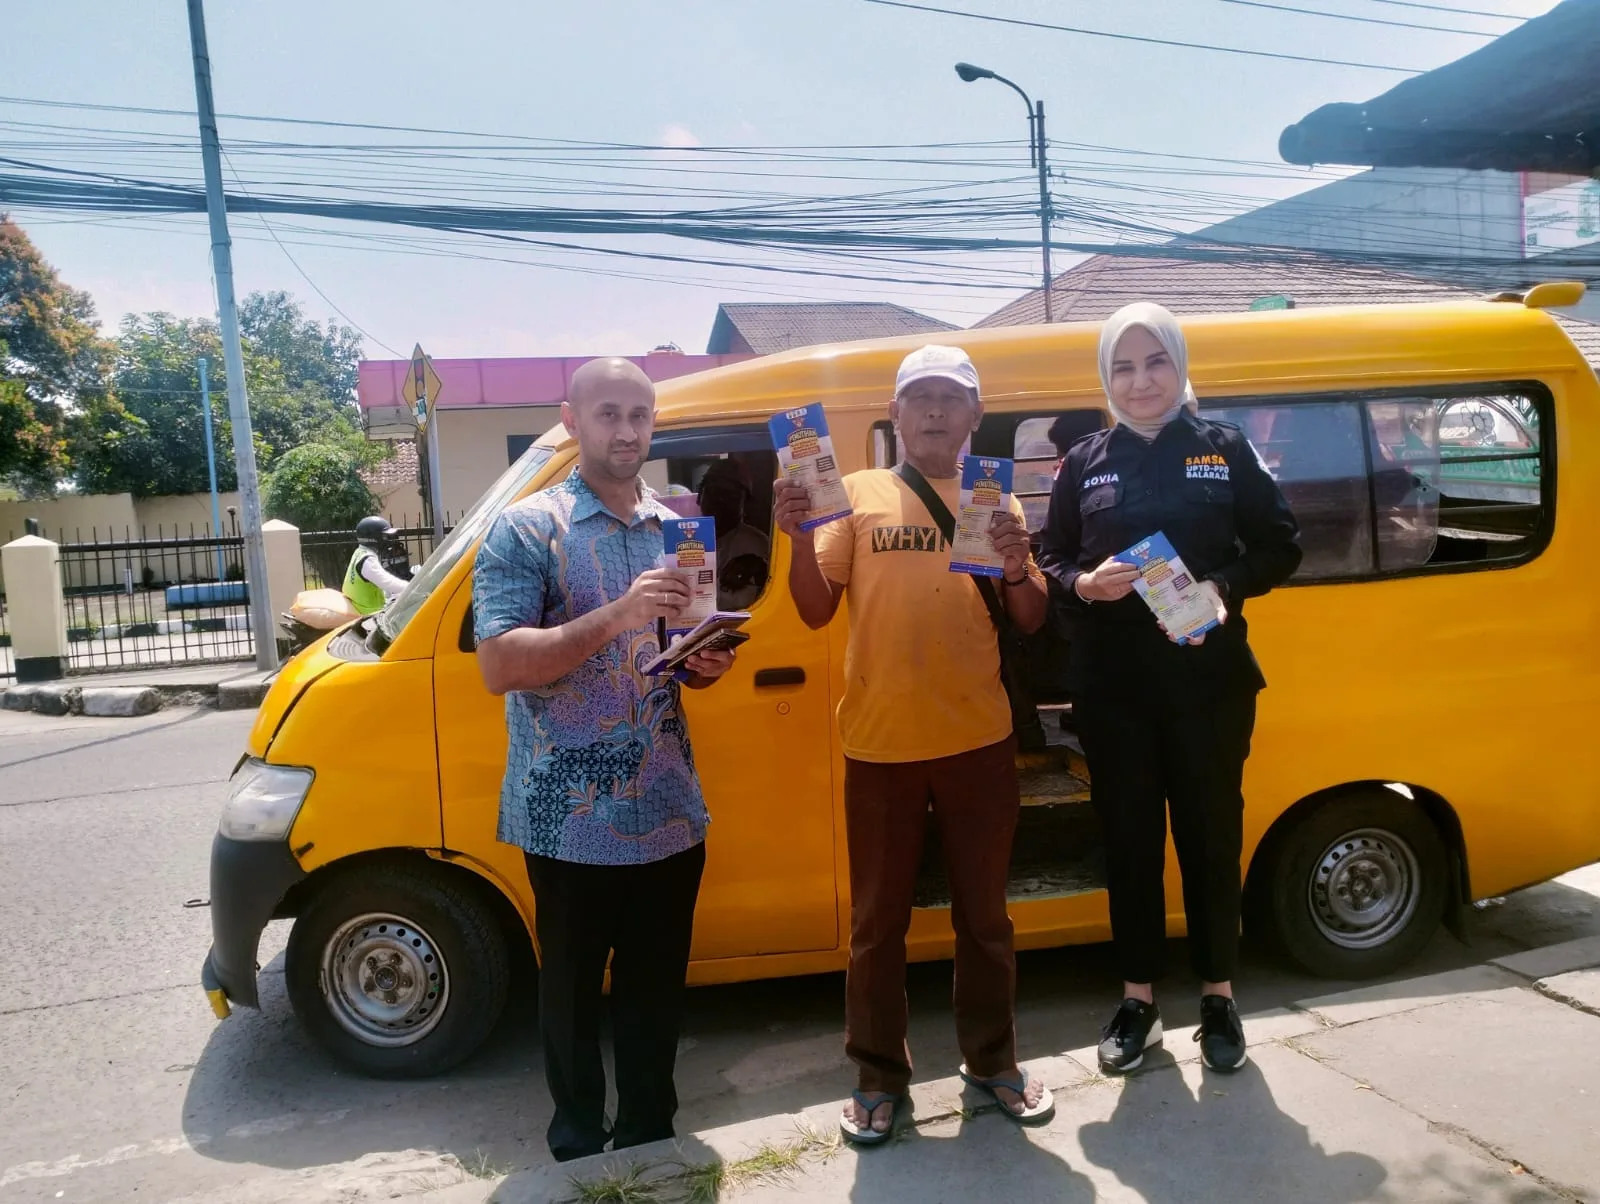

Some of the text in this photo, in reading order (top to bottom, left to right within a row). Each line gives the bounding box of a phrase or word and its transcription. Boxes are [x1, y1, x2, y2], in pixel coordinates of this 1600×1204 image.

[1185, 455, 1227, 465] SAMSA
[1083, 473, 1119, 488] SOVIA
[1186, 471, 1230, 481] BALARAJA
